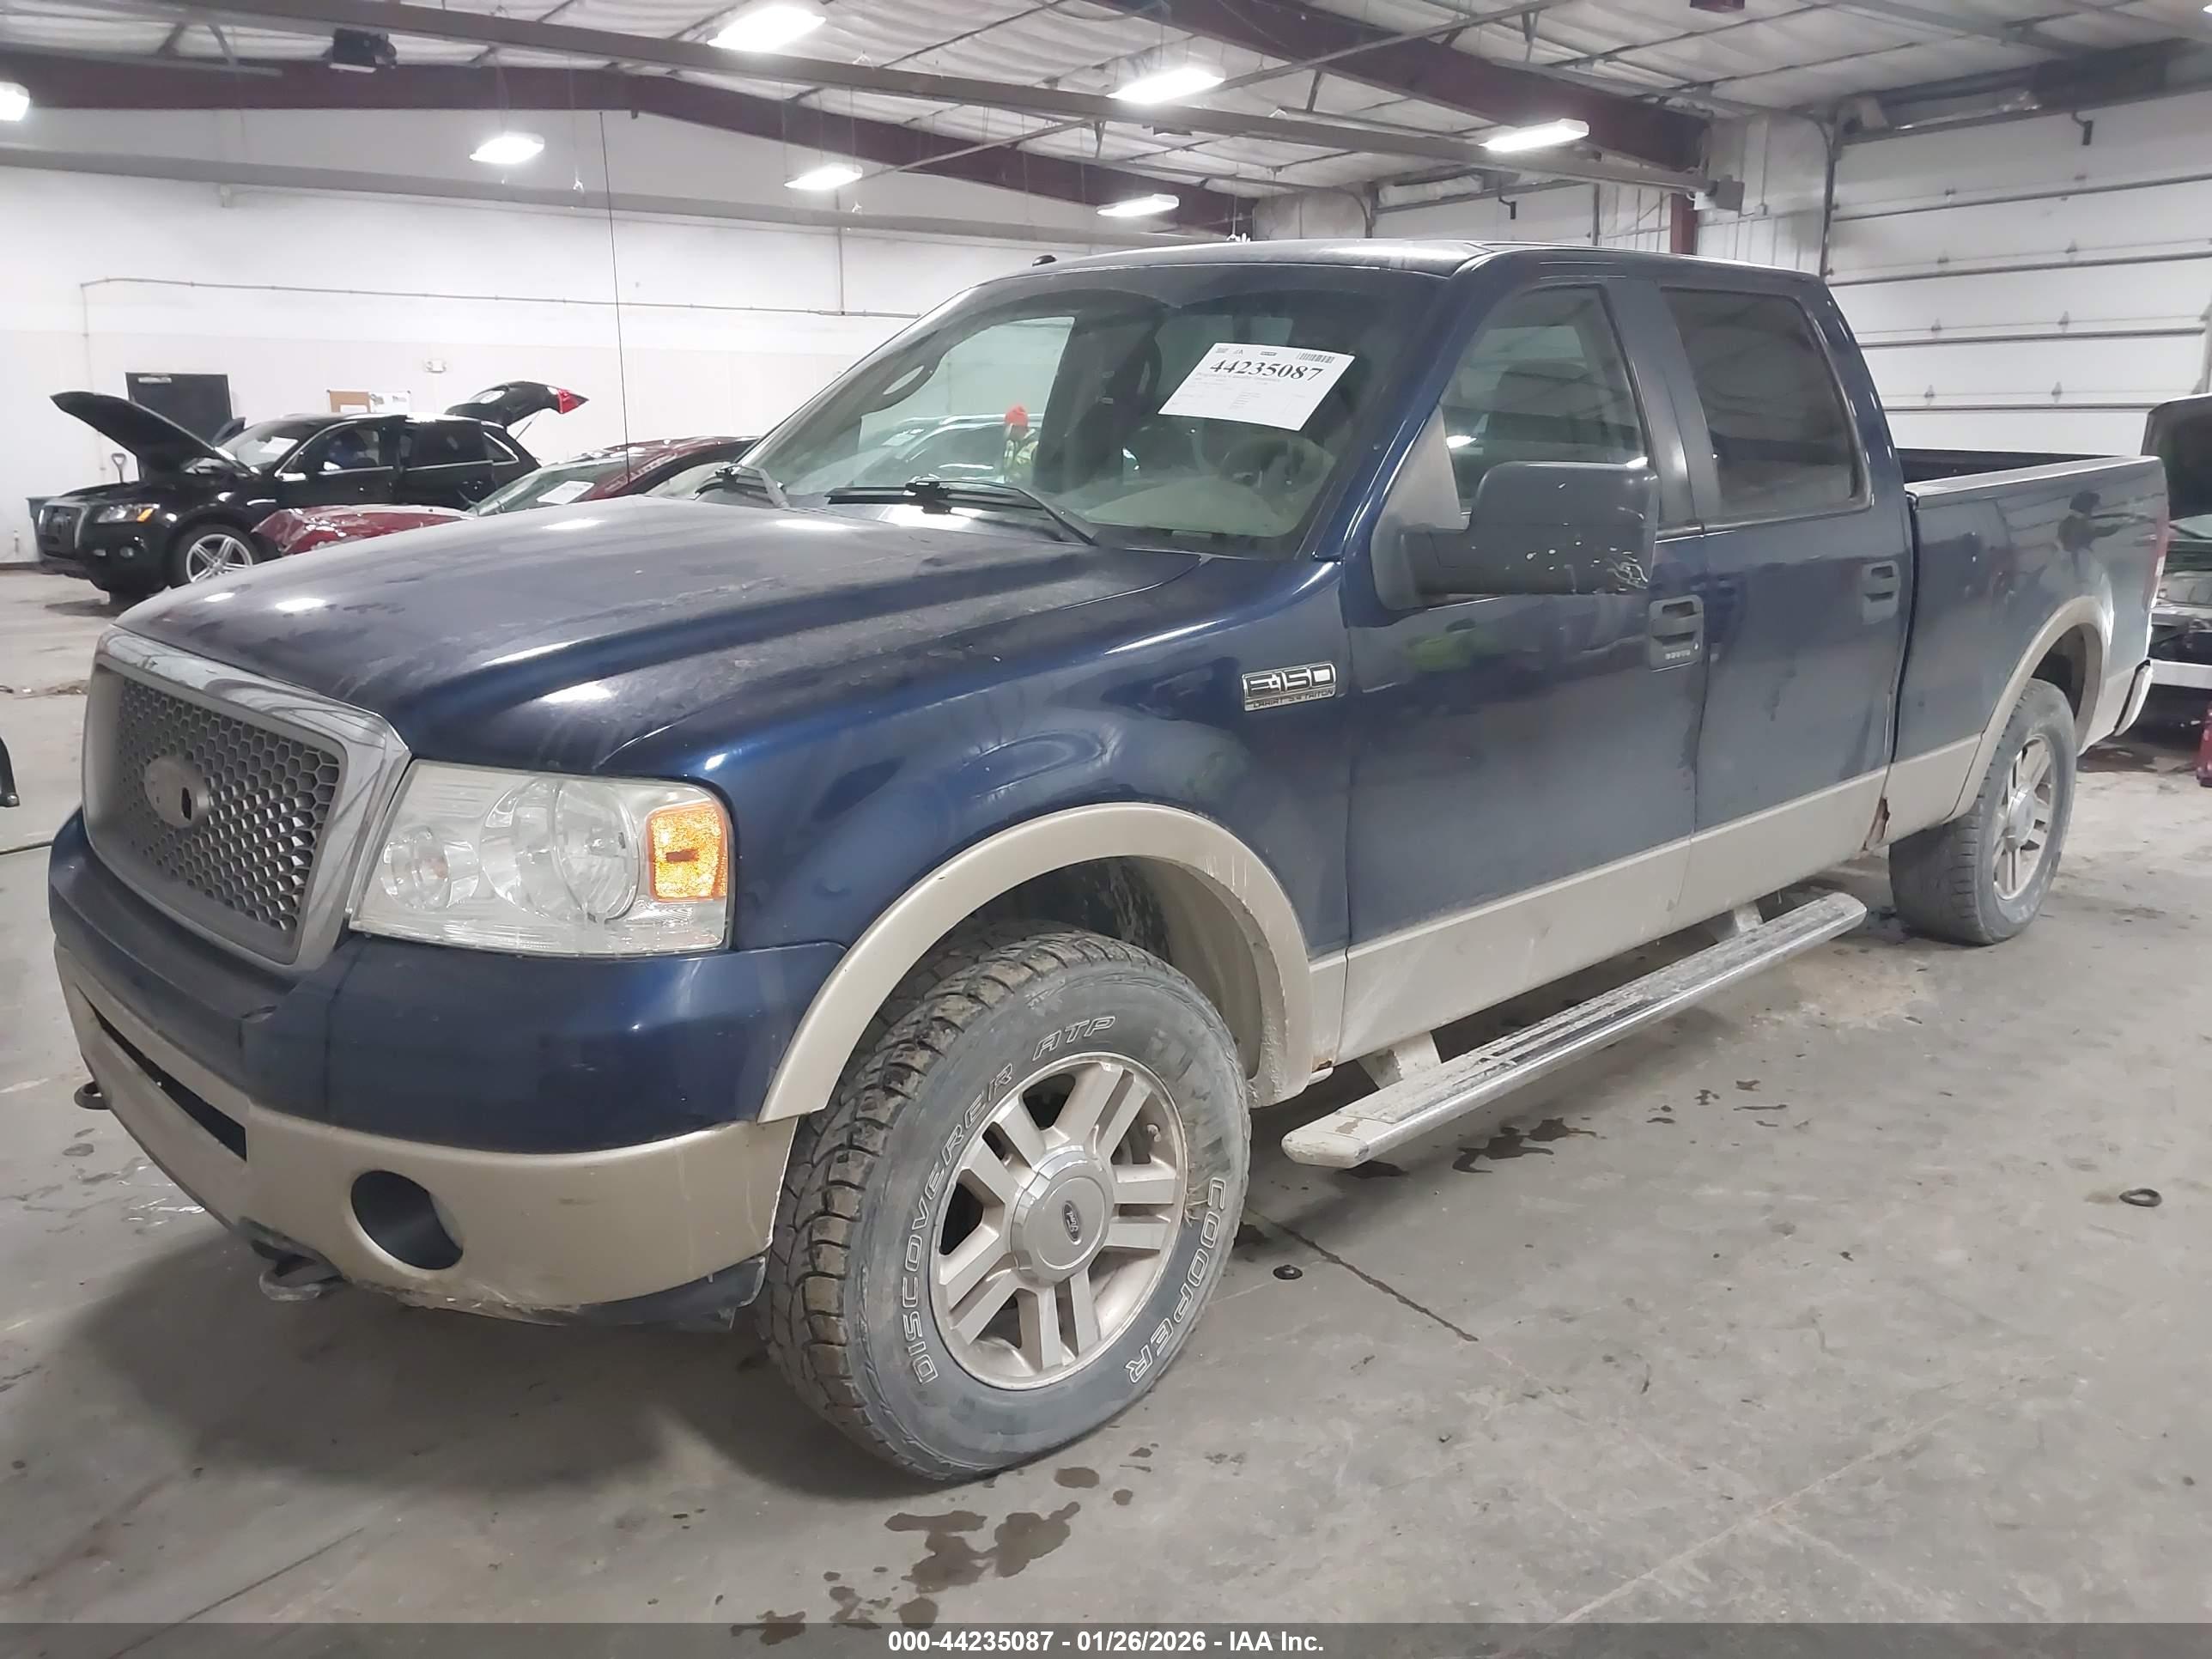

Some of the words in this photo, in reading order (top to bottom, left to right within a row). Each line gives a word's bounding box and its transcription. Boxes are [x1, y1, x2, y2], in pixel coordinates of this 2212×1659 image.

[1210, 359, 1324, 382] 44235087
[902, 1063, 1014, 1386] DISCOVERER
[1032, 1016, 1116, 1062] ATP
[1124, 1176, 1226, 1385] COOPER
